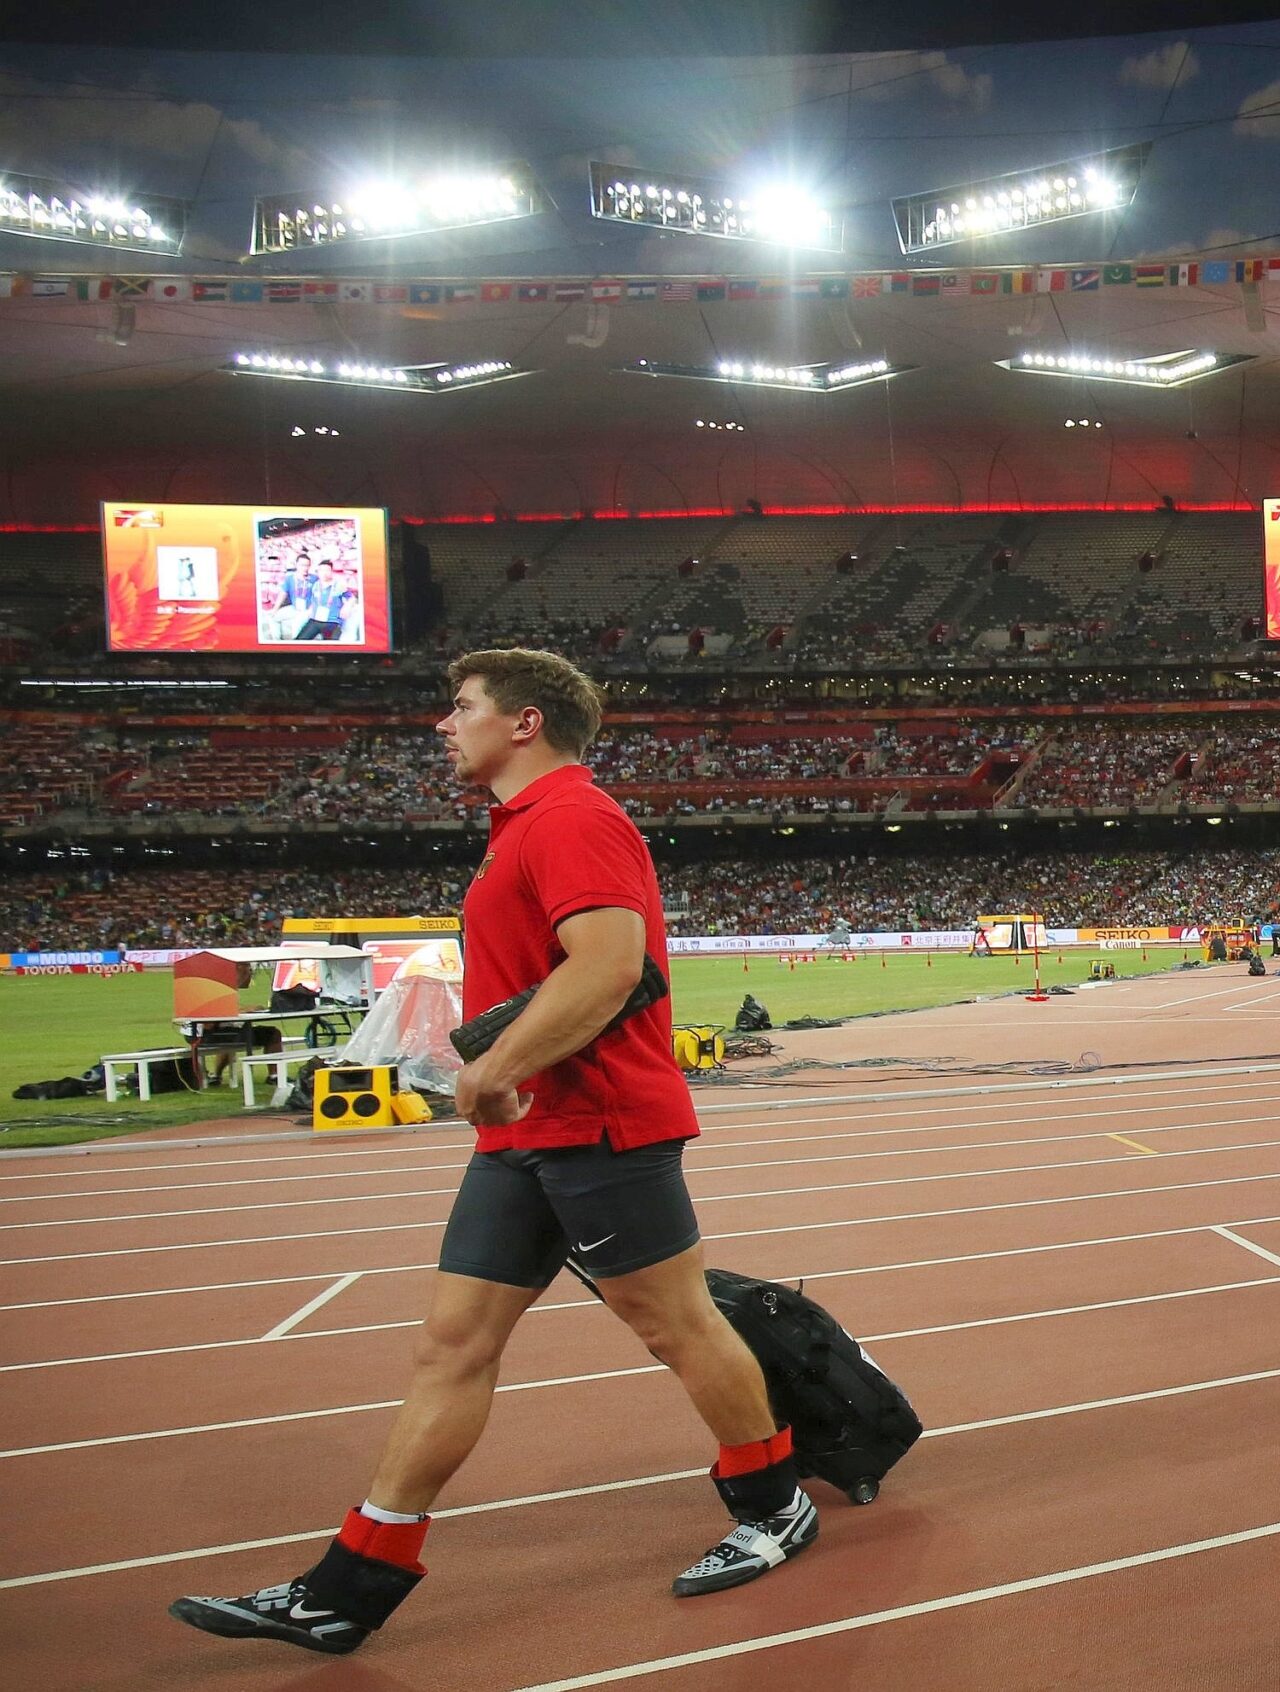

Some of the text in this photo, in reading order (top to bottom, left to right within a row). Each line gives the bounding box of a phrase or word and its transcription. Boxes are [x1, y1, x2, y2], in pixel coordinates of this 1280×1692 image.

[418, 920, 456, 929] SEIKO
[1095, 929, 1150, 940] SEIKO
[1105, 940, 1136, 949] Canon
[40, 953, 104, 965] MONDO
[23, 963, 136, 975] TOYOTA TOYOTA
